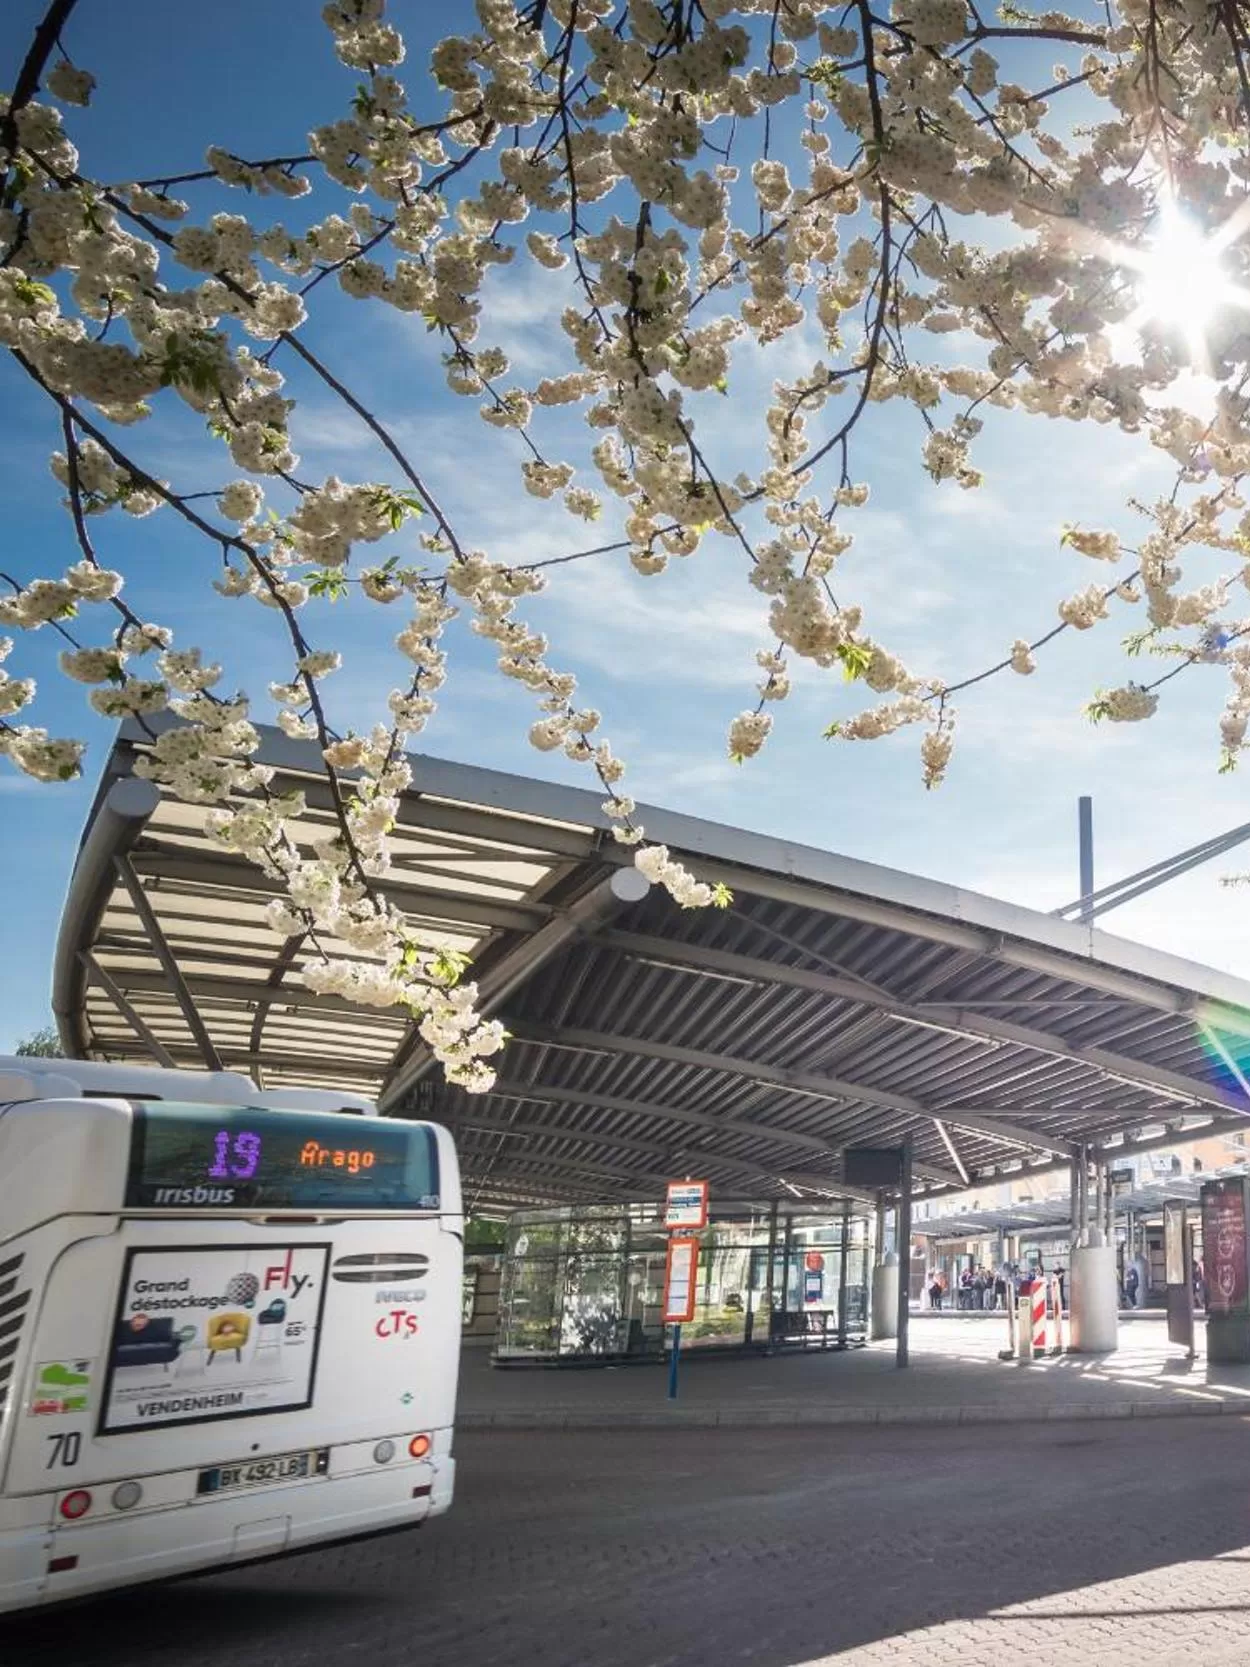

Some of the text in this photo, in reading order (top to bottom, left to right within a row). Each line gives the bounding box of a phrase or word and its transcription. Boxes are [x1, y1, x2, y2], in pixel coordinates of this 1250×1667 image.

[208, 1130, 261, 1178] 19
[300, 1140, 376, 1174] Arago
[133, 1278, 190, 1294] Grand
[130, 1294, 229, 1312] déstockage
[137, 1392, 243, 1416] VENDENHEIM
[46, 1431, 82, 1469] 70
